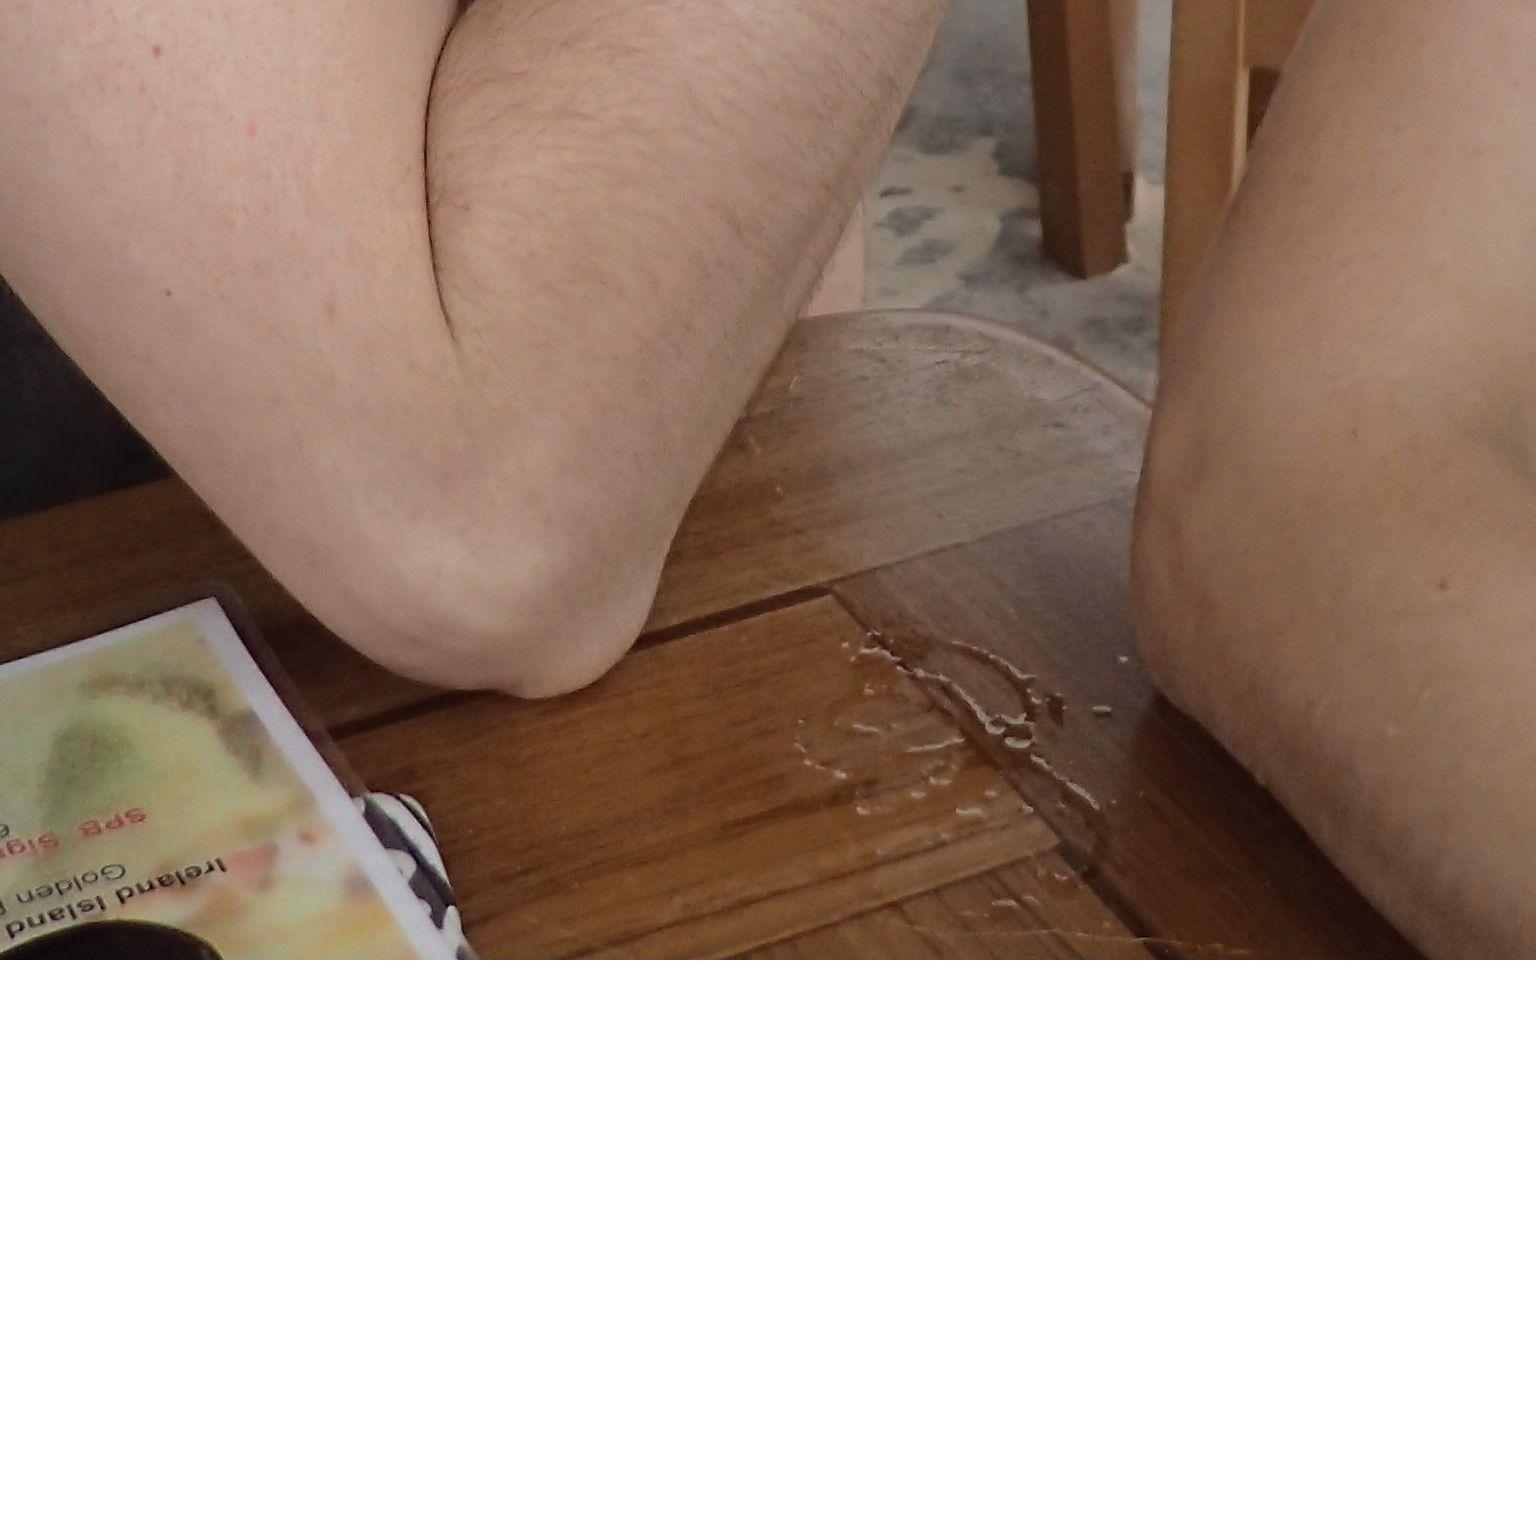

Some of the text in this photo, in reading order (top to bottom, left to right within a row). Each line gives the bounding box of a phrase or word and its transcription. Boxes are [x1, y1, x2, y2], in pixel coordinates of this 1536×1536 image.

[15, 862, 127, 905] Golden
[116, 856, 228, 906] Ireland
[5, 898, 107, 941] Island
